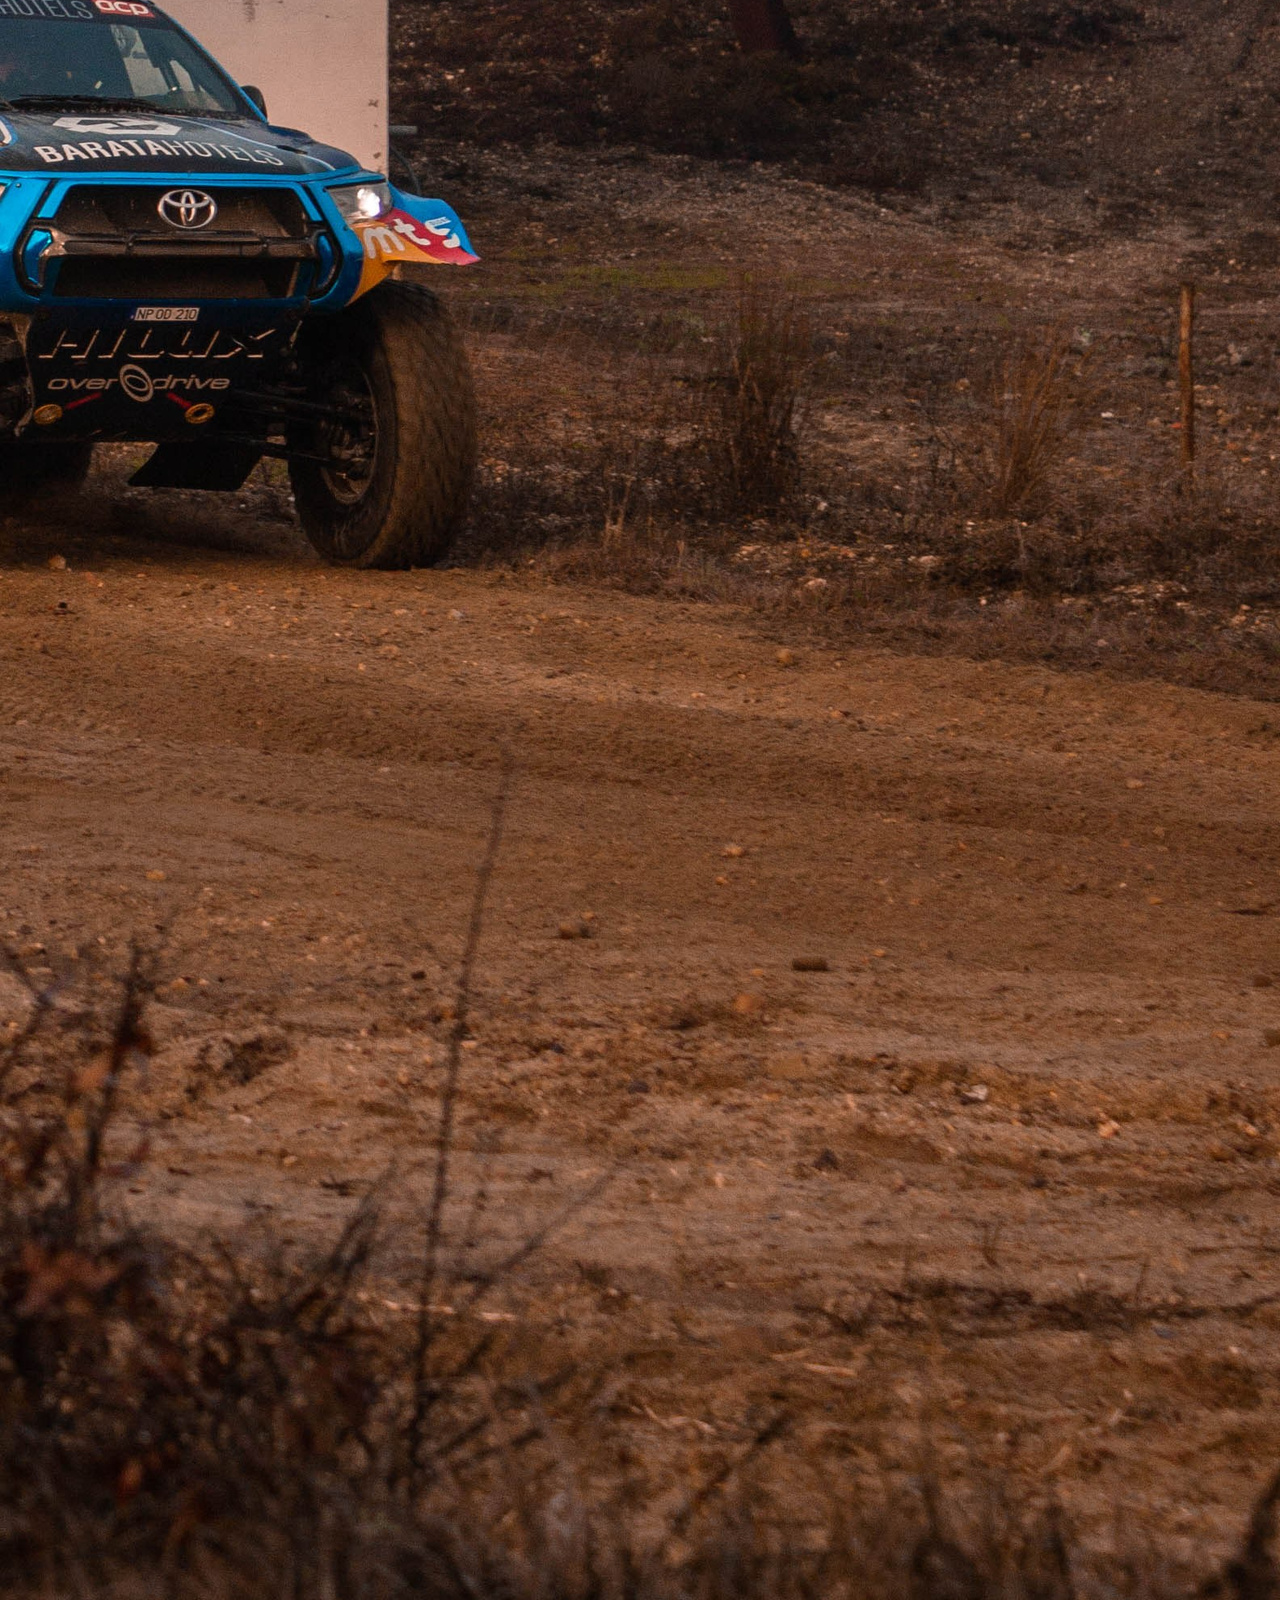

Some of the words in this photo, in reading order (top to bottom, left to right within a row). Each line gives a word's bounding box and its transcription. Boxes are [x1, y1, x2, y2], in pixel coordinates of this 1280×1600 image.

[95, 0, 150, 16] acp
[33, 139, 284, 167] BARATAHOTELS
[363, 217, 461, 260] mts
[175, 308, 198, 320] 210
